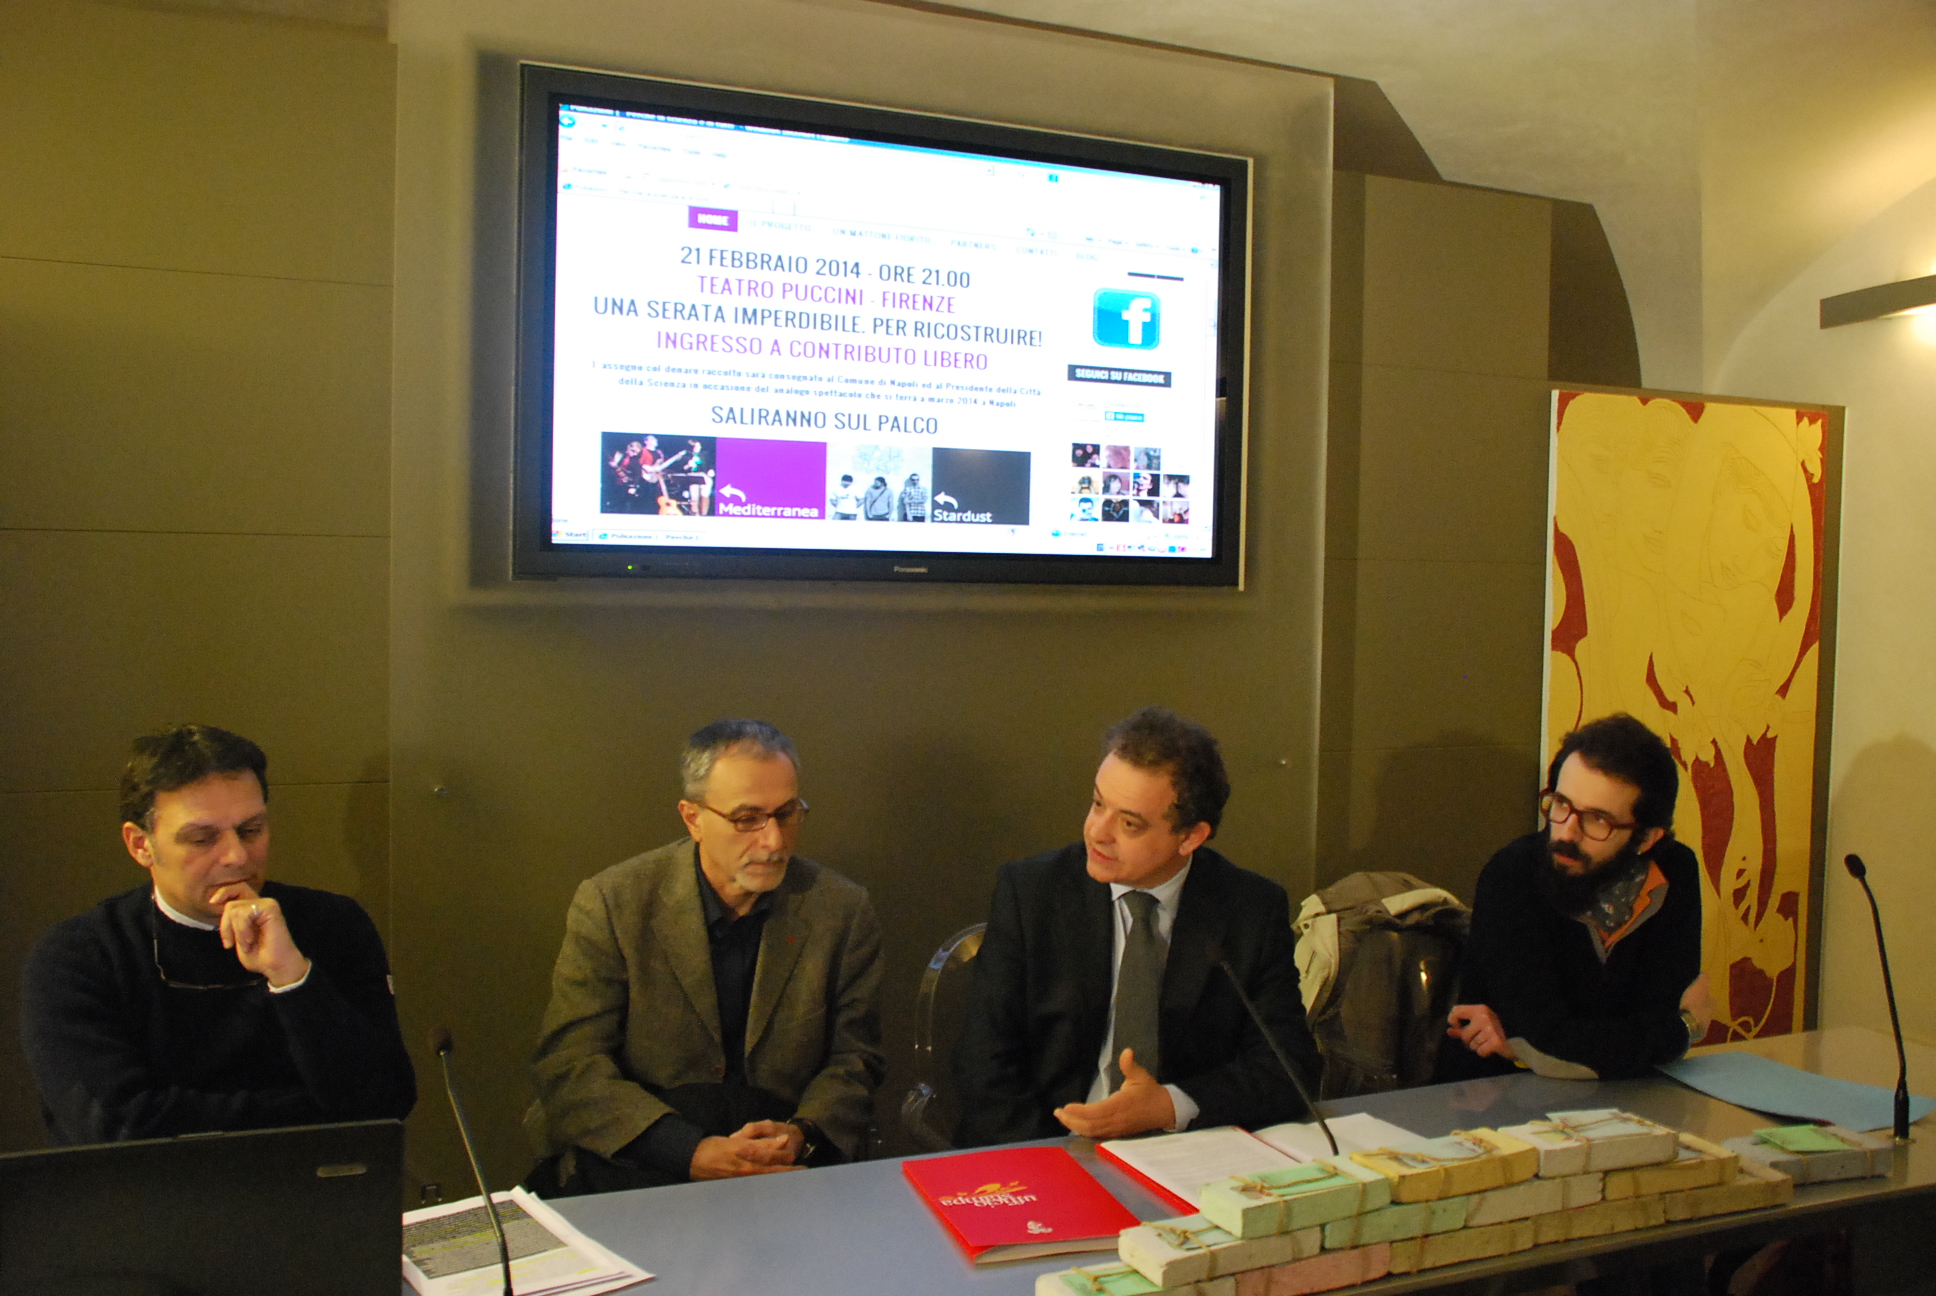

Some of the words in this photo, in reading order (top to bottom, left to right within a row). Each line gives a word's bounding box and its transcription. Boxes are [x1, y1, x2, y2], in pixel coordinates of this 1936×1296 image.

[697, 213, 730, 226] HOME
[950, 239, 998, 251] PARTNERS
[680, 245, 701, 265] 21
[709, 248, 808, 274] FEBBRAIO
[815, 258, 861, 279] 2014
[879, 264, 915, 284] ORE
[922, 267, 970, 289] 21.00
[697, 275, 775, 299] TEATRO
[782, 282, 864, 307] PUCCINI
[881, 291, 956, 315] FIRENZE
[594, 296, 639, 317] UNA
[647, 300, 726, 323] SERATA
[734, 306, 866, 334] IMPERDIBILE.
[873, 317, 907, 337] PER
[914, 320, 1042, 347] RICOSTRUIRE!
[657, 331, 763, 355] INGRESSO
[770, 339, 782, 356] A
[790, 340, 917, 365] CONTRIBUTO
[923, 350, 989, 370] LIBERO
[646, 364, 661, 373] col
[665, 365, 699, 375] denaro
[702, 368, 742, 378] raccolto
[769, 372, 823, 383] consegnato
[826, 375, 834, 383] al
[837, 375, 875, 386] Comune
[878, 378, 887, 387] di
[890, 379, 918, 389] Napoli
[921, 381, 932, 390] ed
[935, 382, 943, 390] al
[945, 382, 993, 394] Presidente
[996, 386, 1018, 395] della
[1110, 370, 1122, 381] SU
[1123, 371, 1165, 384] FACEBOOK
[618, 377, 644, 387] della
[647, 378, 687, 389] Scienza
[702, 383, 751, 392] occasione
[813, 389, 863, 400] spettacolo
[865, 392, 881, 401] che
[927, 396, 954, 405] marzo
[957, 397, 978, 406] 2014
[989, 399, 1017, 409] Napoli
[711, 405, 827, 429] SALIRANNO
[834, 412, 871, 431] SUL
[878, 414, 938, 434] PALCO
[719, 502, 819, 518] Mediterranea
[933, 509, 993, 523] Stardust
